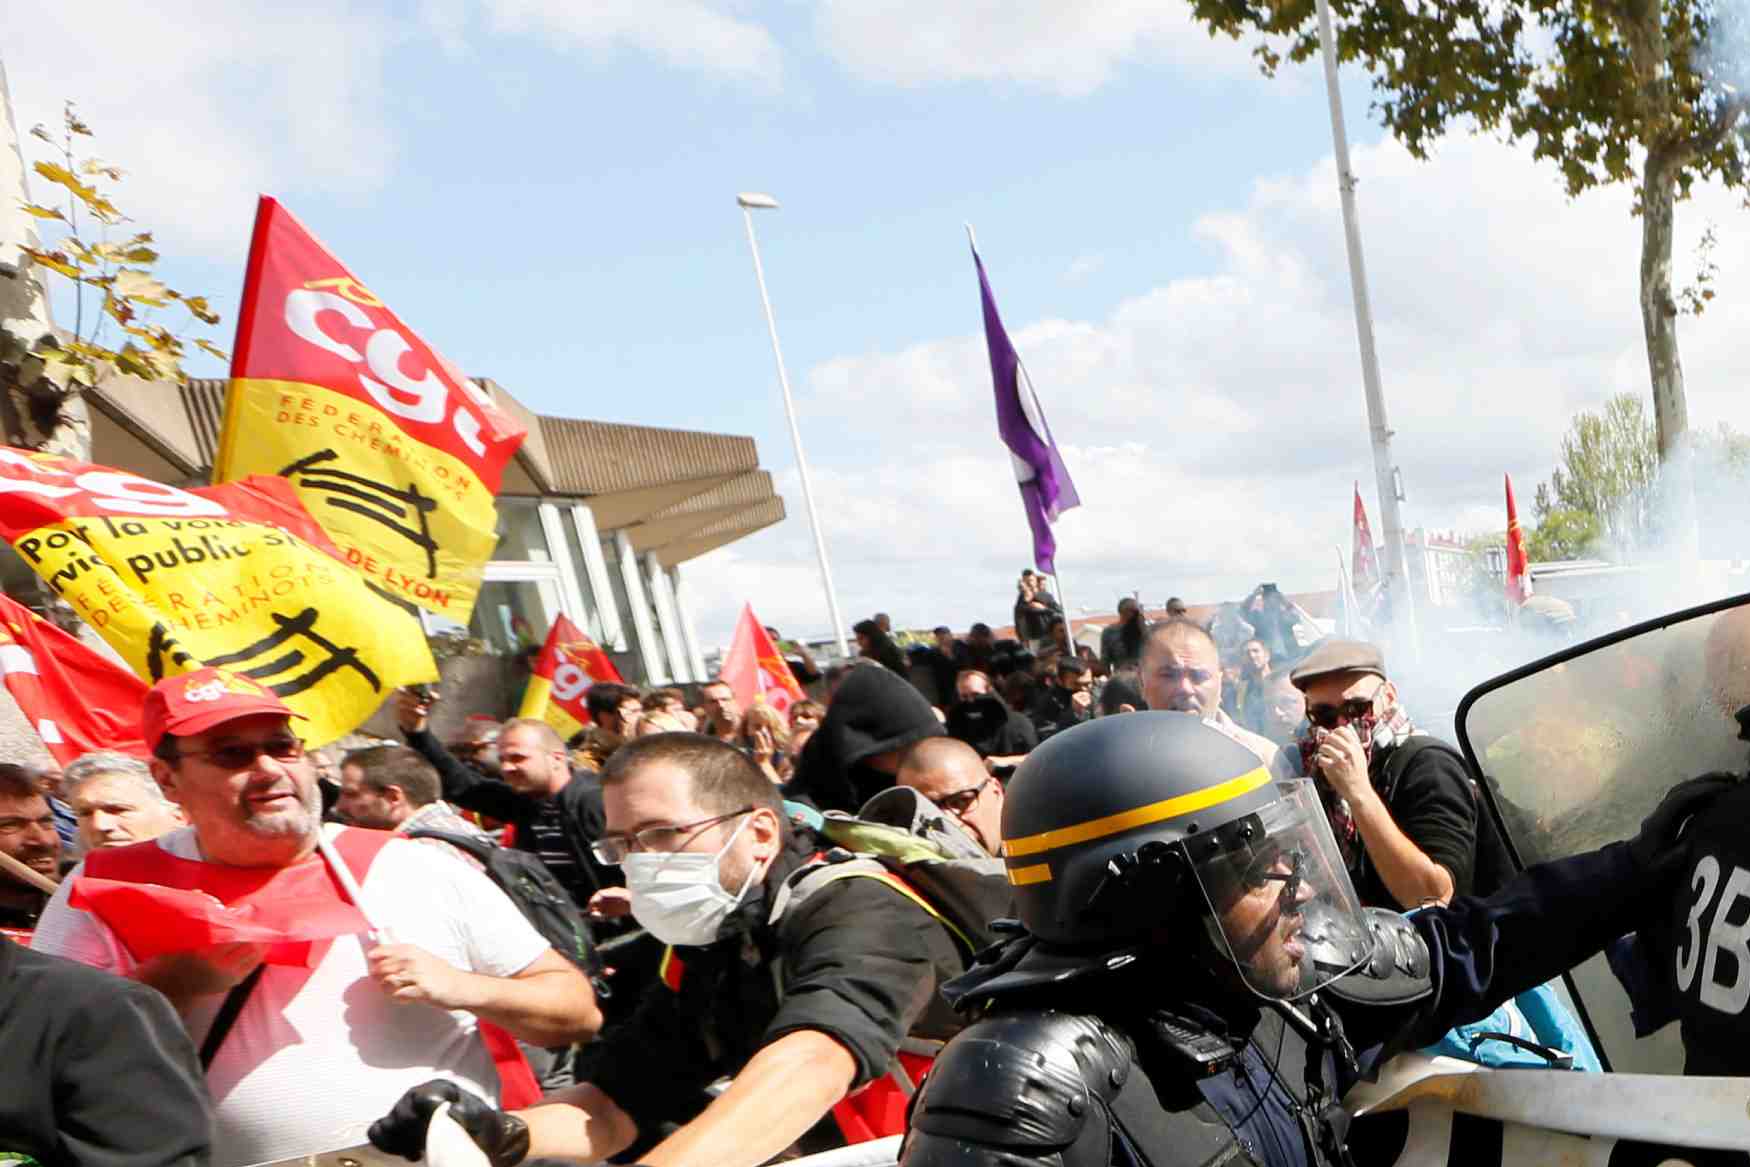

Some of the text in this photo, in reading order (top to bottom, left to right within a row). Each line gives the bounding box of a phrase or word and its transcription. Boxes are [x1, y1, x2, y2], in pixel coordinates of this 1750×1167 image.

[276, 410, 320, 427] DES
[100, 515, 147, 540] la
[345, 547, 450, 607] DE LYON
